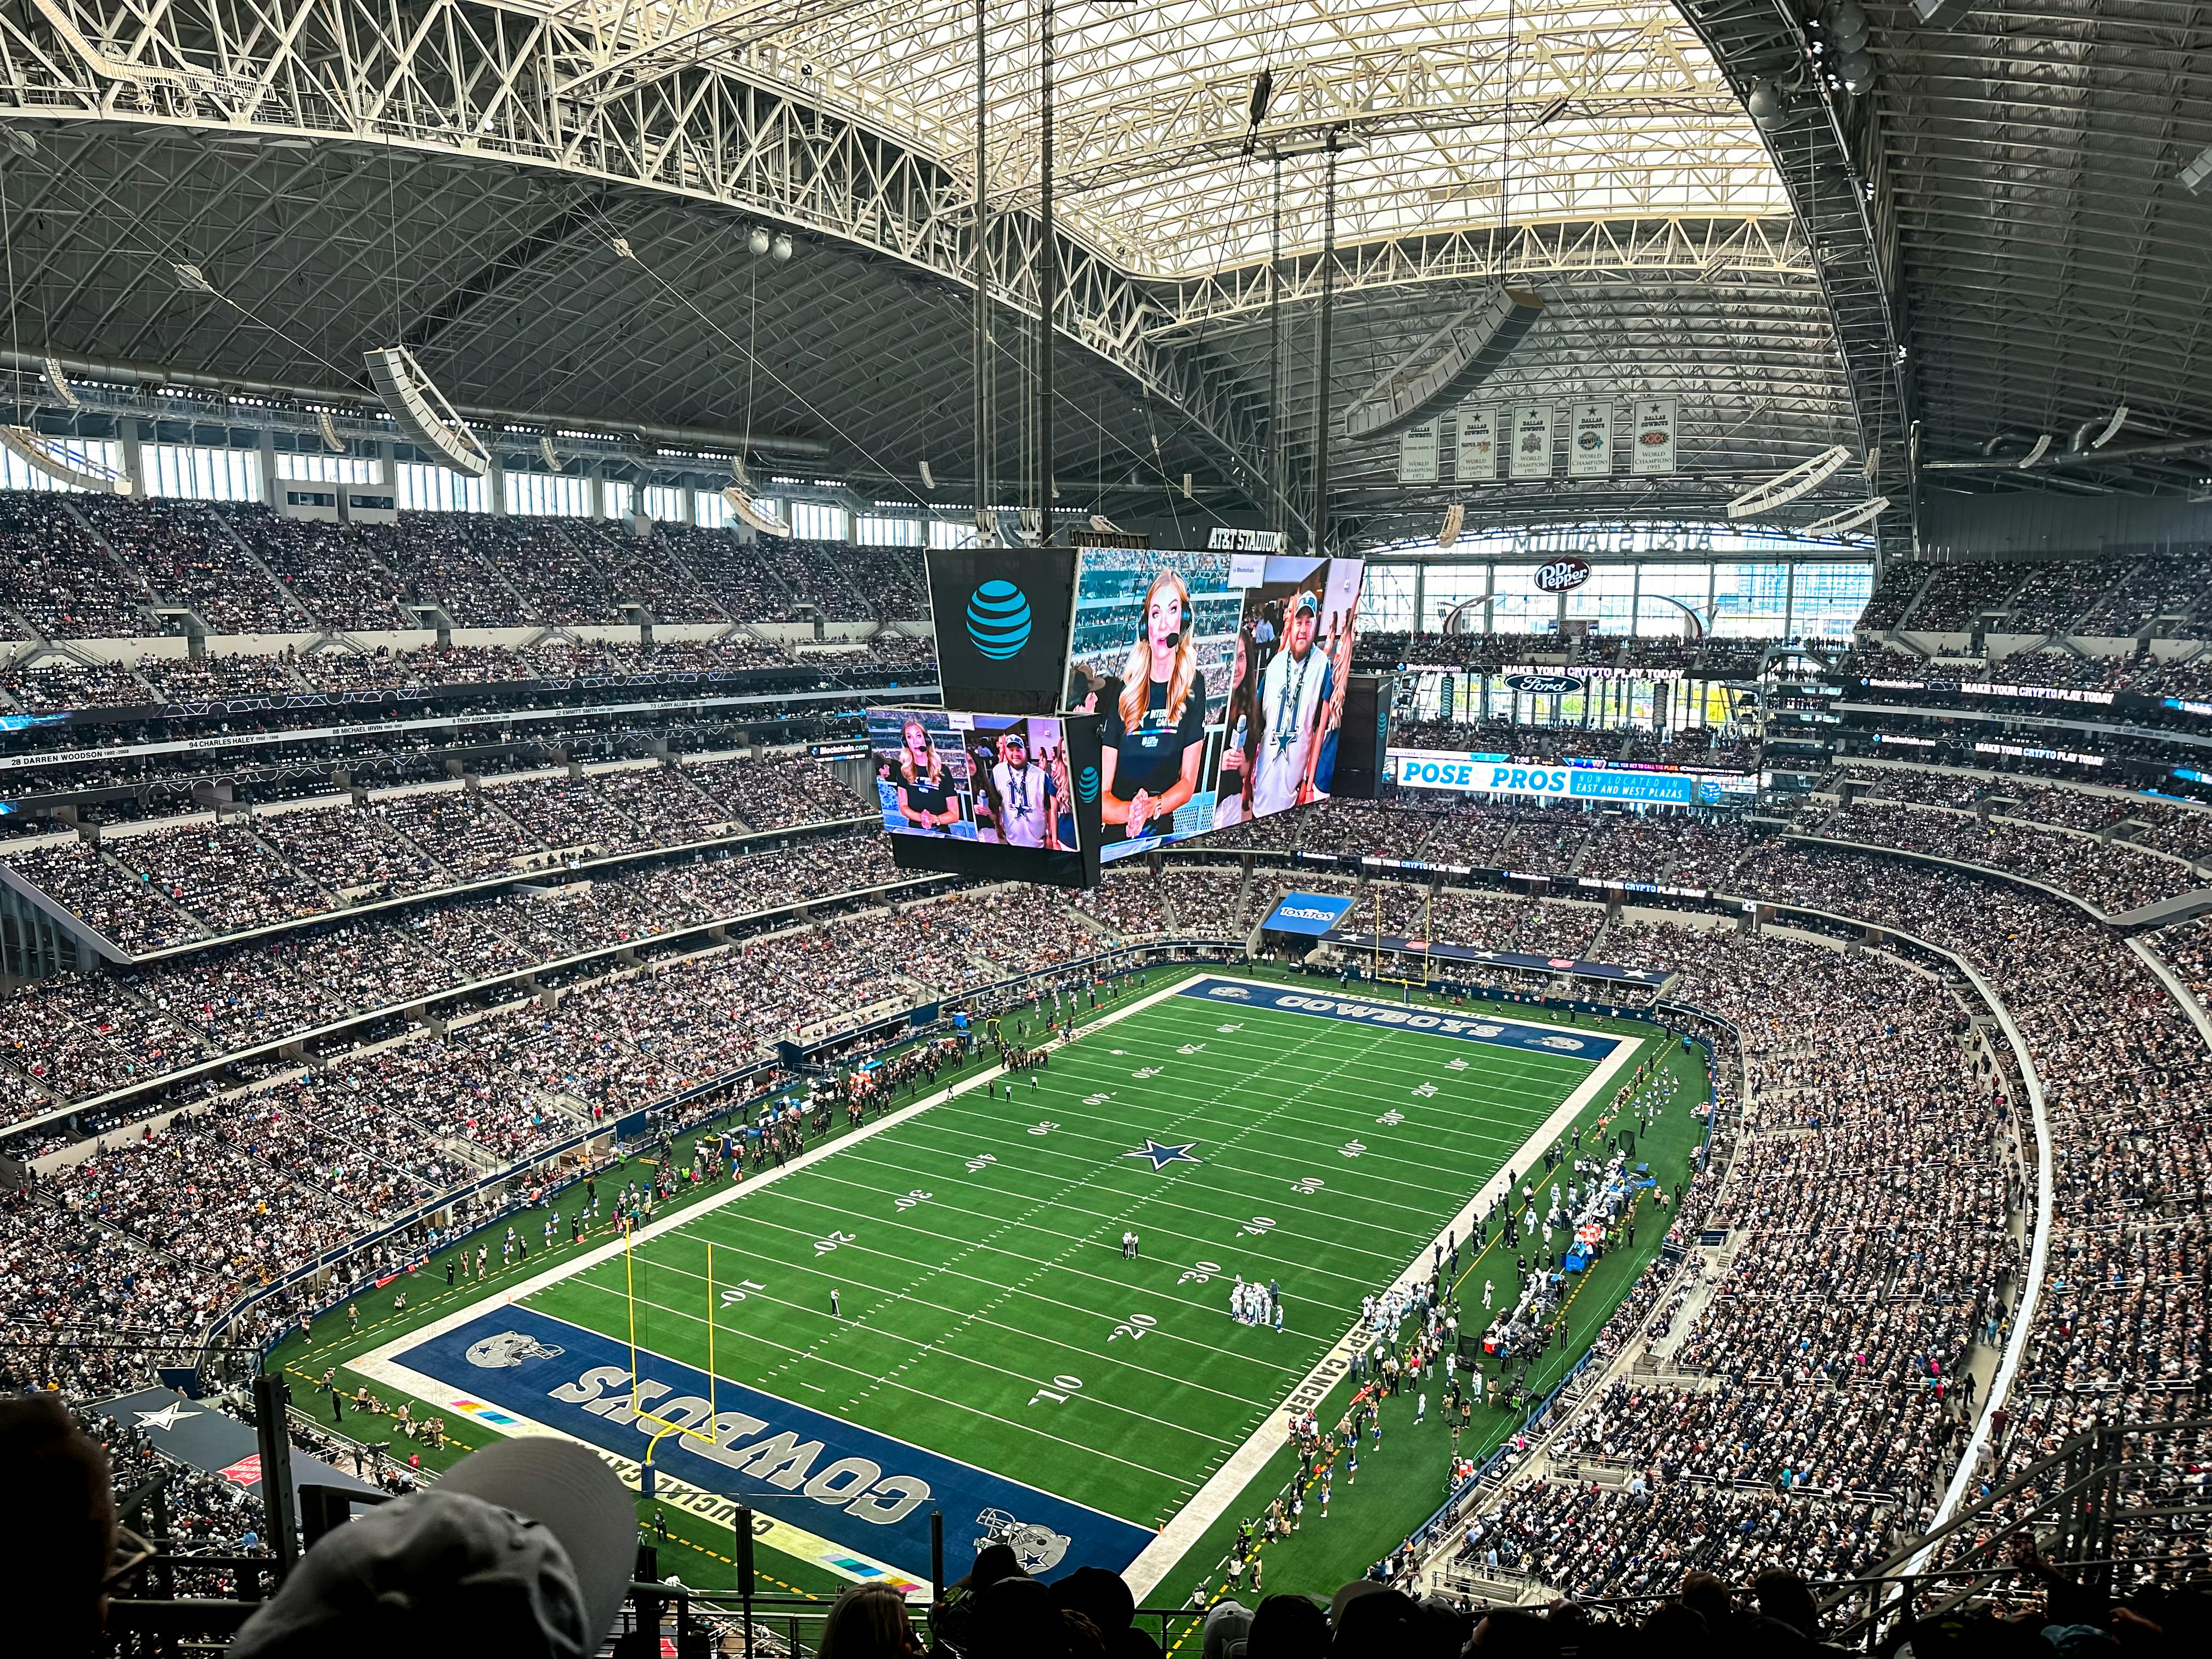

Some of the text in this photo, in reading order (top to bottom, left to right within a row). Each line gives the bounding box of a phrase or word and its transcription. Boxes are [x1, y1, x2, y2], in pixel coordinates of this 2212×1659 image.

[1645, 434, 1664, 443] XXX
[1207, 527, 1282, 552] AT&T STADIUM
[1536, 565, 1588, 589] Pepper
[1555, 562, 1575, 577] Dr
[1406, 664, 1462, 673] Blockchain.com
[1502, 665, 1685, 679] MAKE YOUR CRYPTO PLAY TODAY
[1520, 675, 1567, 693] Ford
[1869, 678, 1924, 689] Blockchain.com
[1961, 682, 2114, 704] MAKE YOUR CRYPTO PLAY TODAY
[199, 739, 231, 747] CHARLES
[1881, 734, 1936, 747] Blockchain.com
[24, 755, 59, 764] DARREN
[61, 751, 103, 761] WOODSON
[820, 744, 868, 755] Blockchain.com
[1975, 742, 2104, 766] MAKE YOUR CRYPTO PLAY TODAY
[1403, 762, 1472, 785] POSE
[1490, 768, 1566, 792] PROS
[1579, 774, 1678, 788] NOW LOCATED IN
[1576, 783, 1683, 799] EAST AND WEST PLAZAS
[1361, 856, 1472, 875] MAKE YOUR CRYPTO PLAY TODAY
[1578, 877, 1707, 899] MAKE YOUR CRYPTO PLAY TODAY
[1339, 993, 1395, 1005] TAKES
[1403, 1003, 1434, 1012] ALL
[1274, 994, 1505, 1037] COWBOYS
[1216, 1023, 1242, 1034] 10
[1176, 1043, 1204, 1054] 20
[1131, 1066, 1161, 1079] 30
[1444, 1060, 1470, 1071] 10
[1082, 1093, 1110, 1105] 40
[1410, 1085, 1439, 1098] 20
[1375, 1111, 1405, 1126] 30
[1027, 1121, 1061, 1136] 50
[1337, 1142, 1367, 1158] 40
[964, 1153, 998, 1169] 40
[1290, 1177, 1325, 1195] 50
[893, 1189, 933, 1207] 30
[1242, 1216, 1277, 1236] 40
[813, 1229, 856, 1251] 20
[1181, 1261, 1222, 1284] 30
[720, 1278, 768, 1302] 10
[1113, 1313, 1158, 1341] 20
[1036, 1374, 1084, 1405] 10
[1282, 1358, 1348, 1415] CANCER
[547, 1365, 931, 1526] COWBOYS
